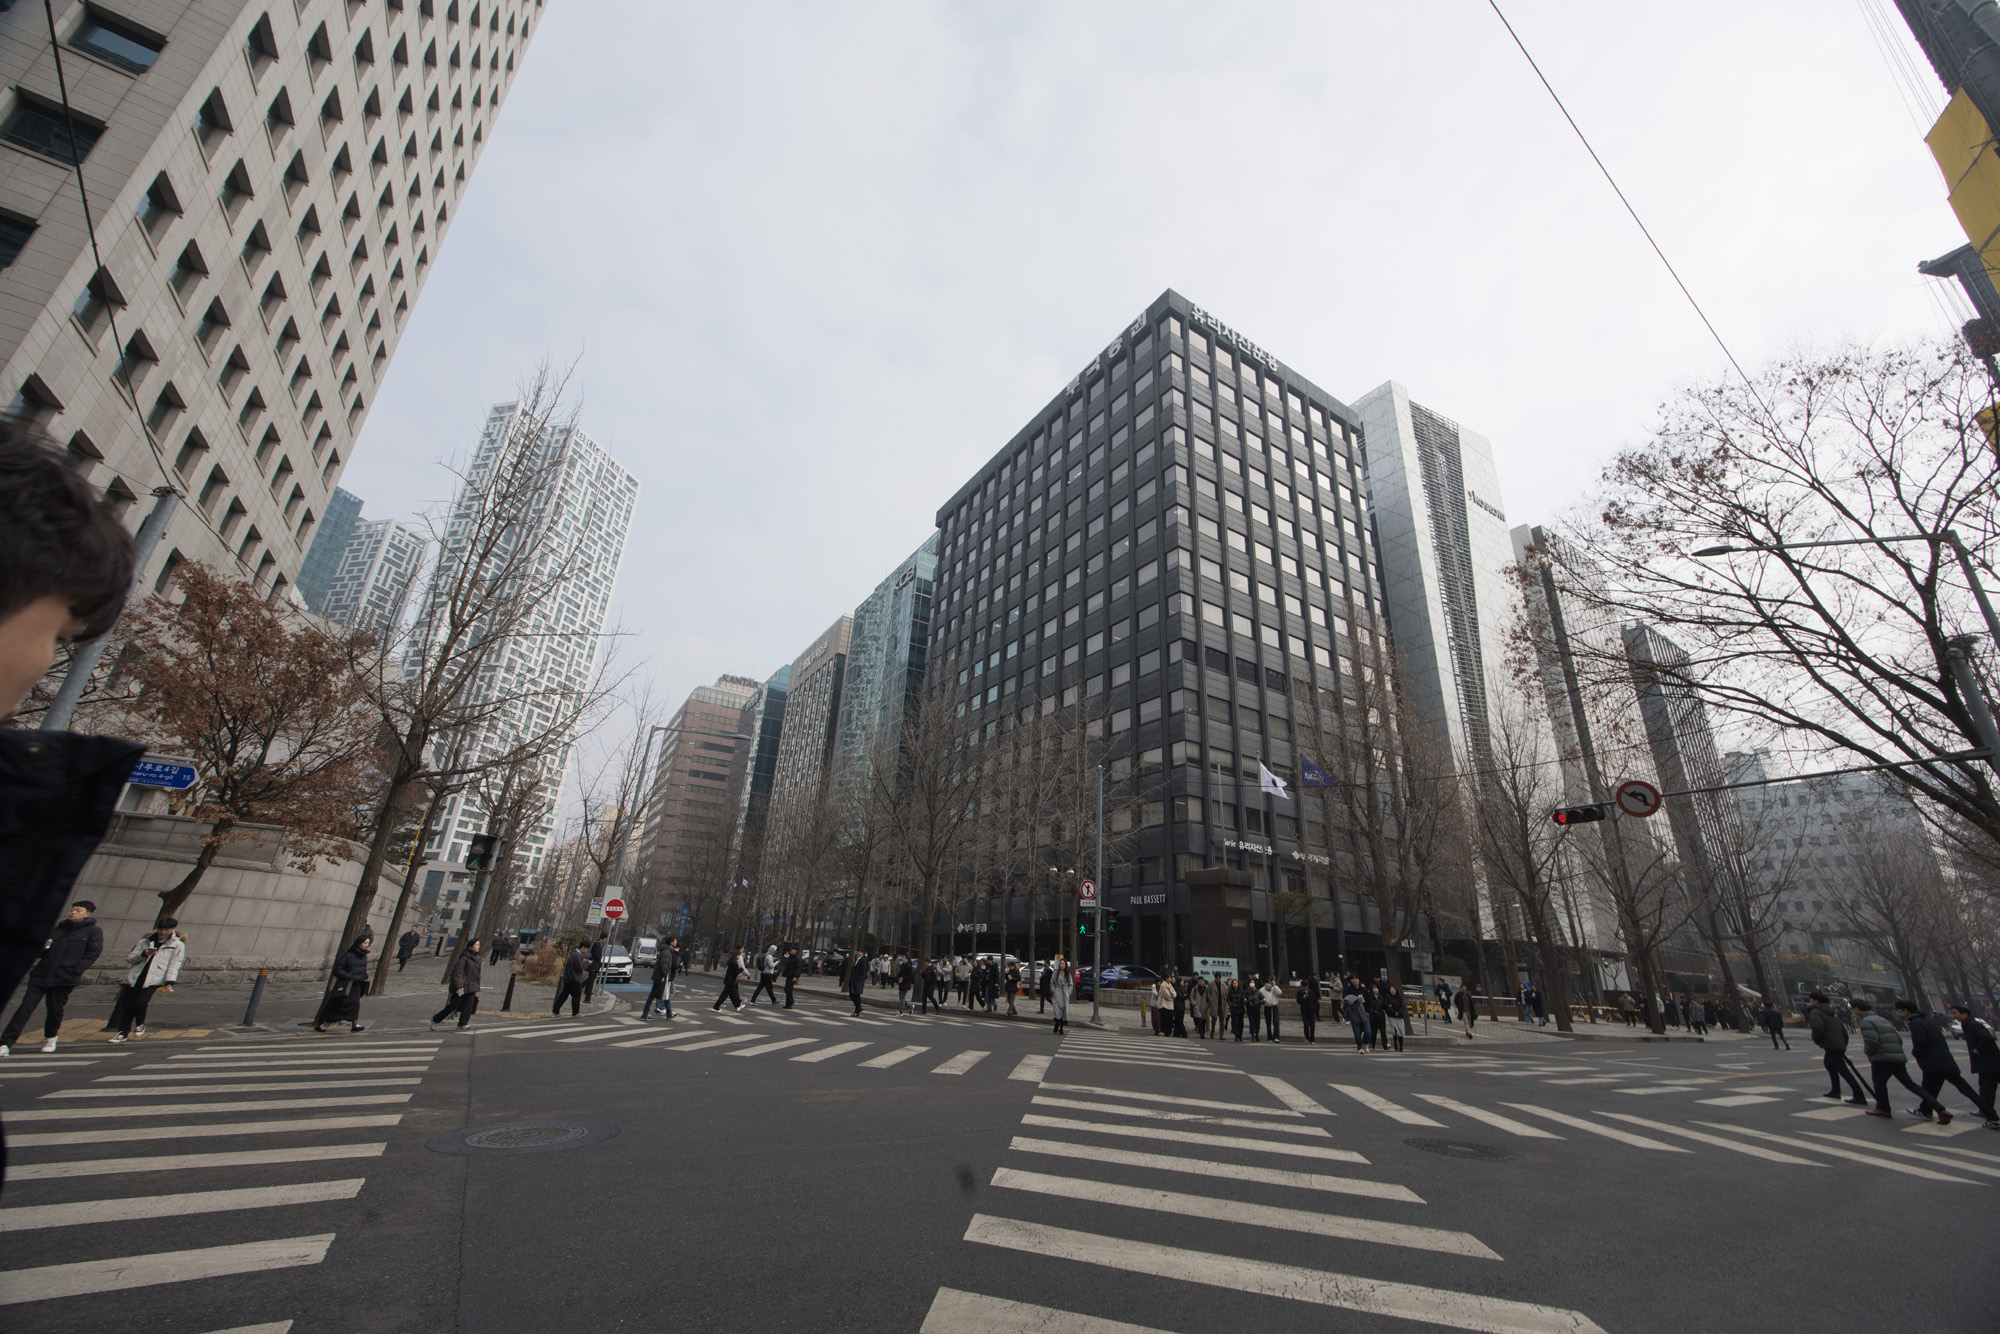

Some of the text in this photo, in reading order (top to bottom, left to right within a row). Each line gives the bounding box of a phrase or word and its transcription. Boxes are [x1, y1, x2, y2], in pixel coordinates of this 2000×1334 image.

[1066, 309, 1147, 396] 부국증권
[1191, 304, 1279, 372] 유리자산운용
[722, 674, 759, 689] KANTAR
[1130, 893, 1166, 905] PAUL BASSETT
